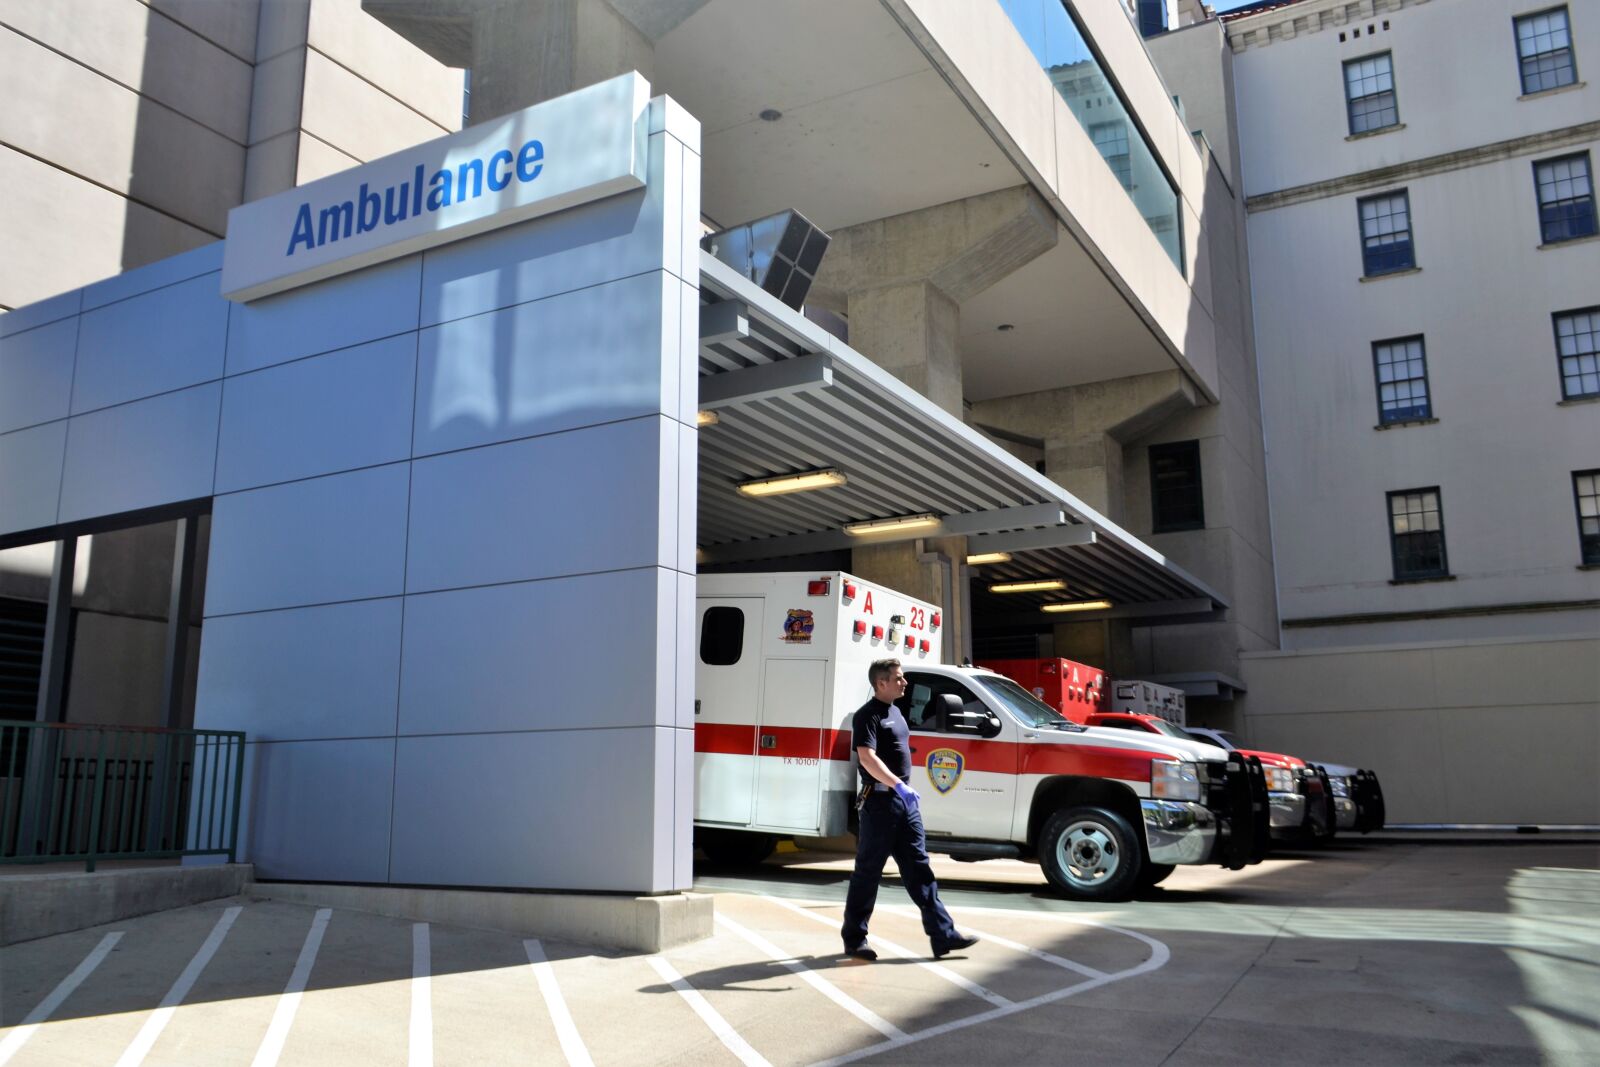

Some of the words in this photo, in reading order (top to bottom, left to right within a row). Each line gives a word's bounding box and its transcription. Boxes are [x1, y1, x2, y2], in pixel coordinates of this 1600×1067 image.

[286, 139, 544, 256] Ambulance
[863, 591, 874, 615] A
[911, 606, 924, 631] 23
[1073, 667, 1079, 683] A
[1154, 688, 1159, 702] A
[795, 758, 819, 767] 101017
